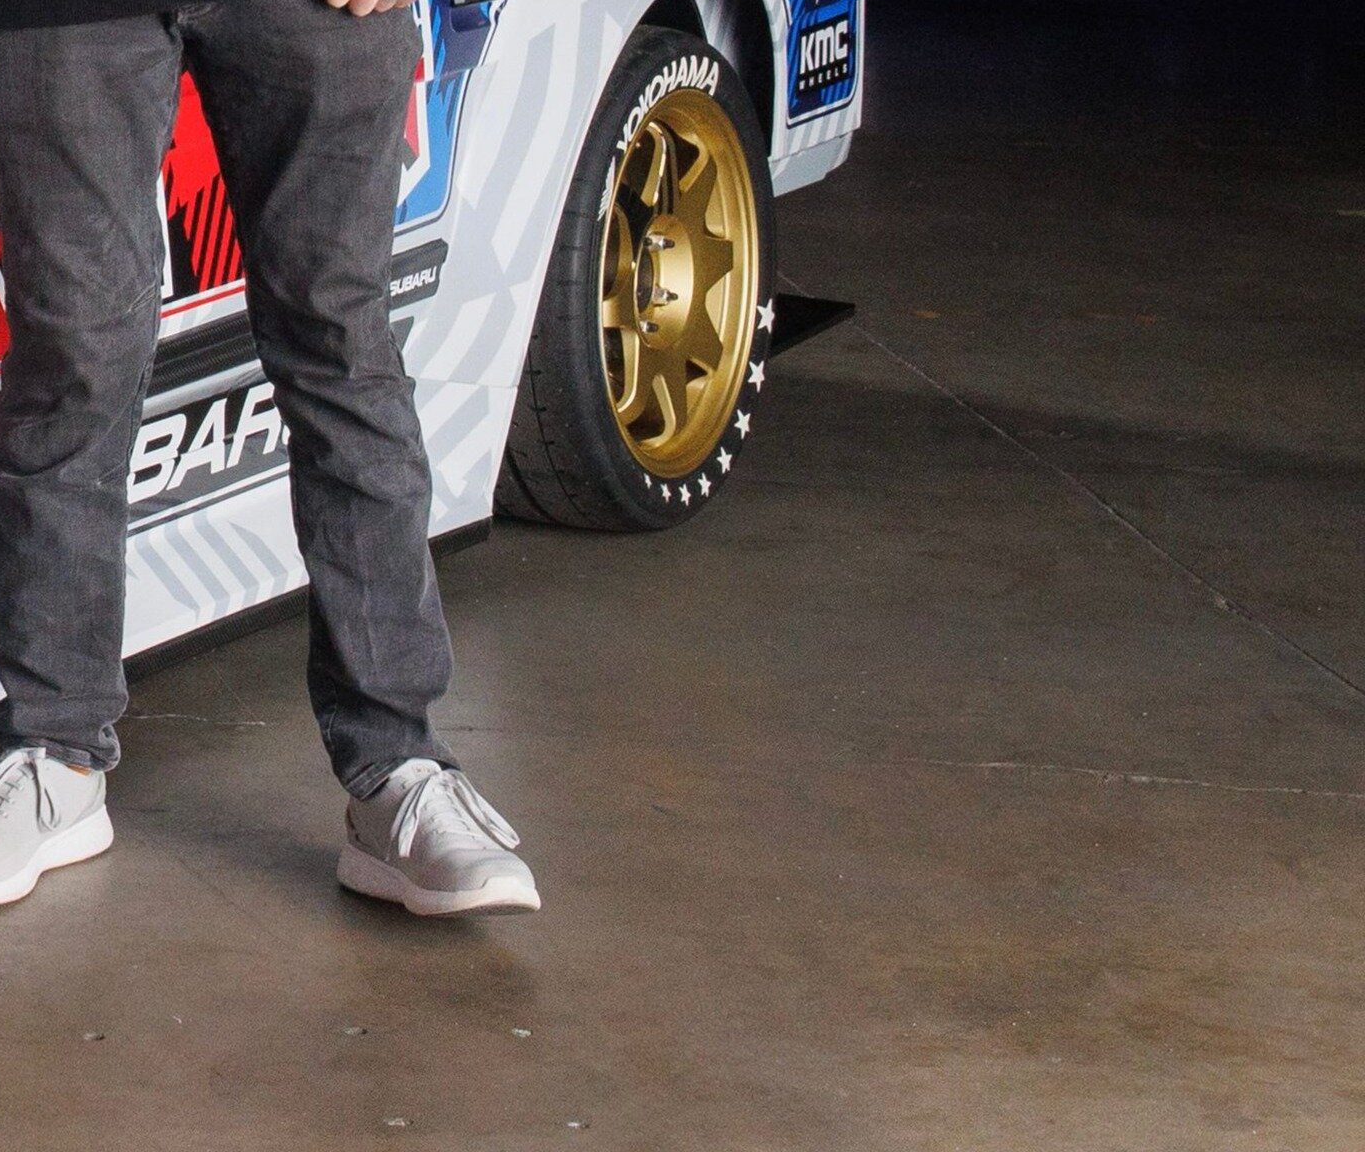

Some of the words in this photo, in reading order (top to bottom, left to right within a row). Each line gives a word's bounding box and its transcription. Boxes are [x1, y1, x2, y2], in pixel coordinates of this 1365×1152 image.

[616, 54, 720, 154] YOKOHAMA
[799, 63, 848, 90] WHEELS
[389, 265, 437, 297] SUBARU
[127, 381, 291, 505] BAR
